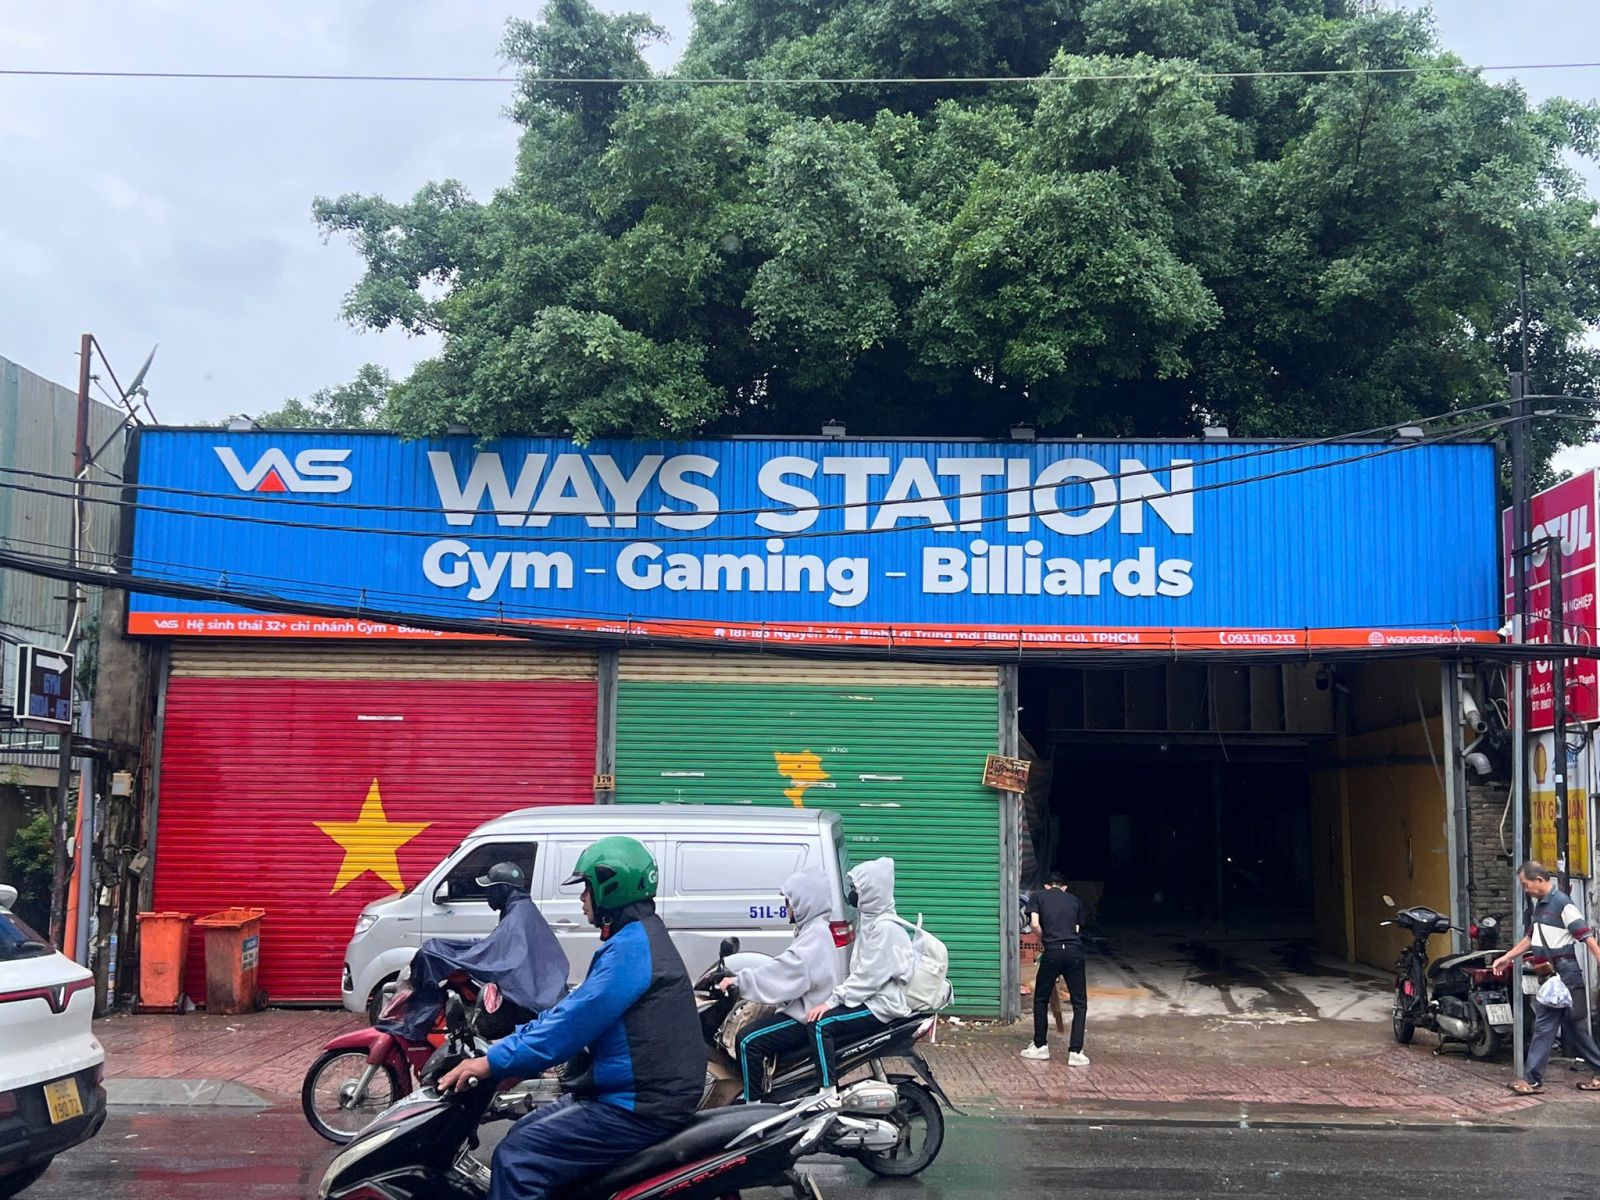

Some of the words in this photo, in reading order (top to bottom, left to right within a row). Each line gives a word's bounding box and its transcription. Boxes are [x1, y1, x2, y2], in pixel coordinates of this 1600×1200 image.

[213, 447, 353, 493] VAS
[427, 451, 720, 531] WAYS
[754, 456, 1194, 536] STATION
[422, 539, 573, 602] Gym
[616, 538, 869, 607] Gaming
[922, 539, 1194, 596] Billiards
[153, 620, 179, 629] VAS
[186, 619, 206, 633] Hệ
[207, 619, 235, 630] sinh
[237, 619, 263, 631] thái
[265, 621, 288, 631] 32+
[313, 621, 354, 633] nhánh
[357, 623, 387, 635] Gym
[1092, 633, 1139, 643] TPHCM
[1227, 633, 1296, 644] 093.1161.233
[750, 906, 787, 918] 51L-8
